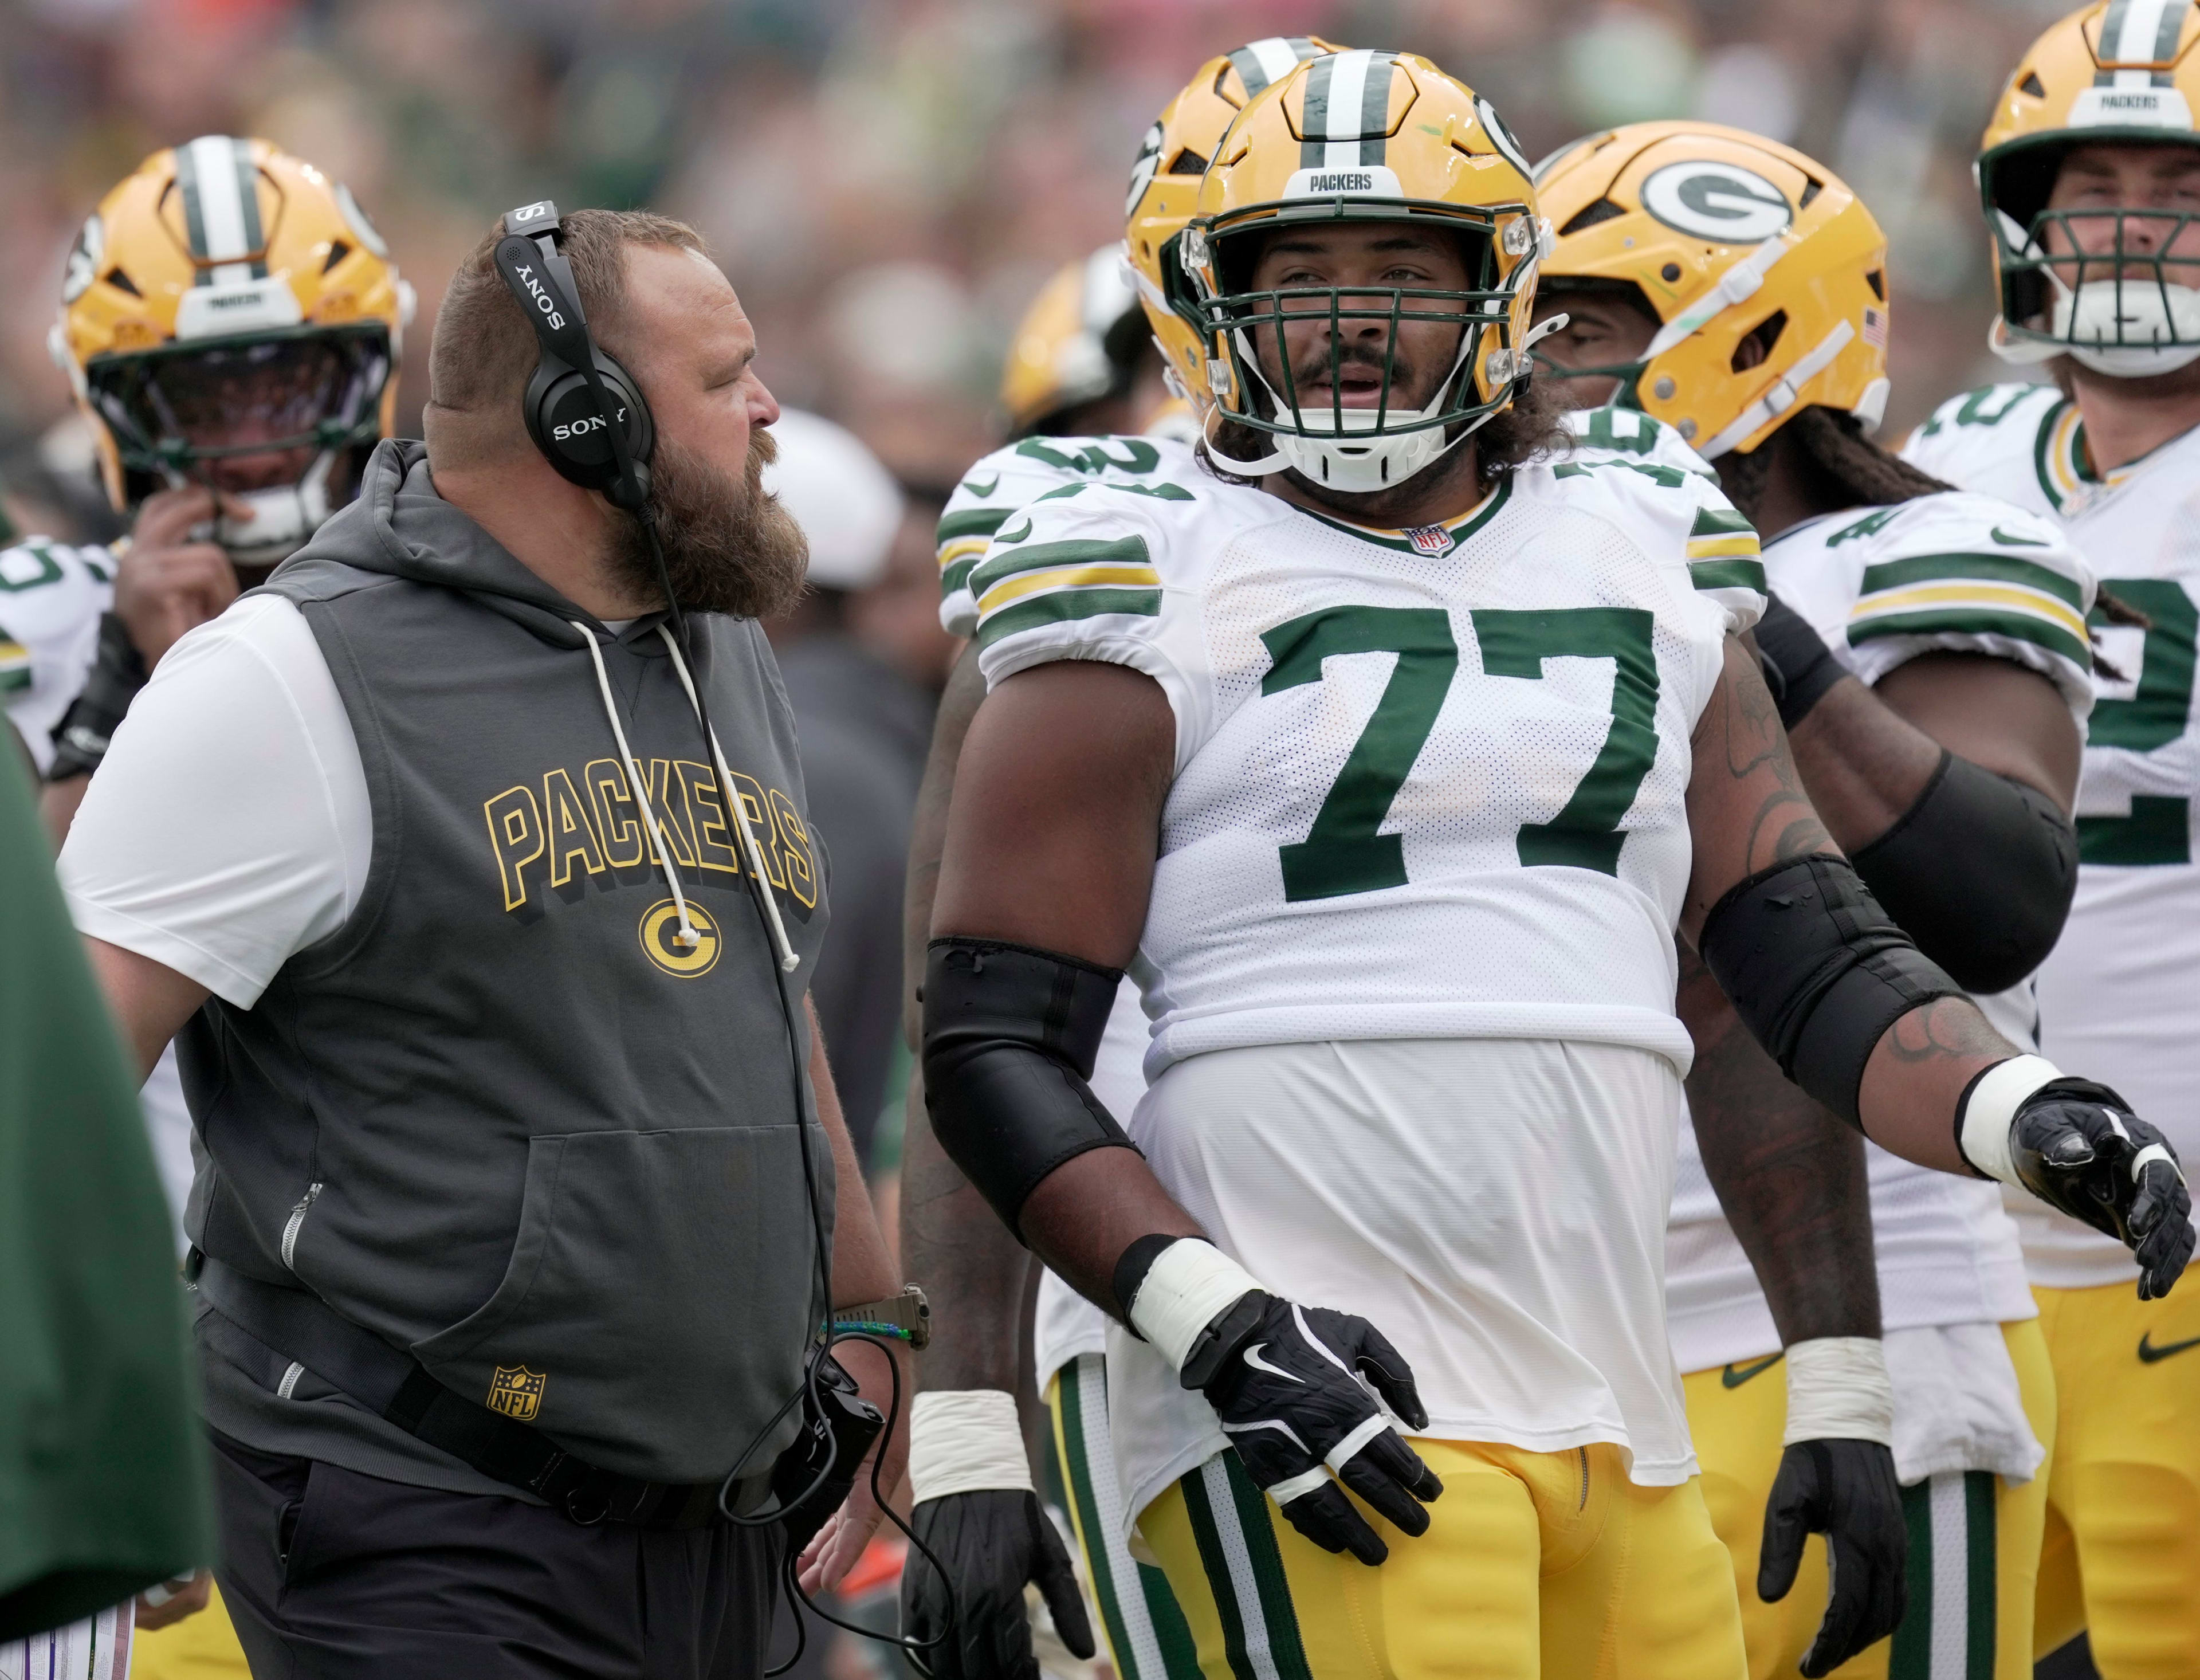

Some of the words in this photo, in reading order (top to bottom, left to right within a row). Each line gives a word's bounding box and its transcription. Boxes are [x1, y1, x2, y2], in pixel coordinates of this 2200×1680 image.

[1310, 174, 1372, 192] PACKERS
[515, 264, 566, 331] SONY
[553, 407, 626, 441] SONY
[1416, 532, 1447, 548] NFL
[1259, 605, 1660, 902] 77
[484, 758, 817, 912] PACKERS
[642, 902, 718, 974] G
[493, 1389, 532, 1415] NFL
